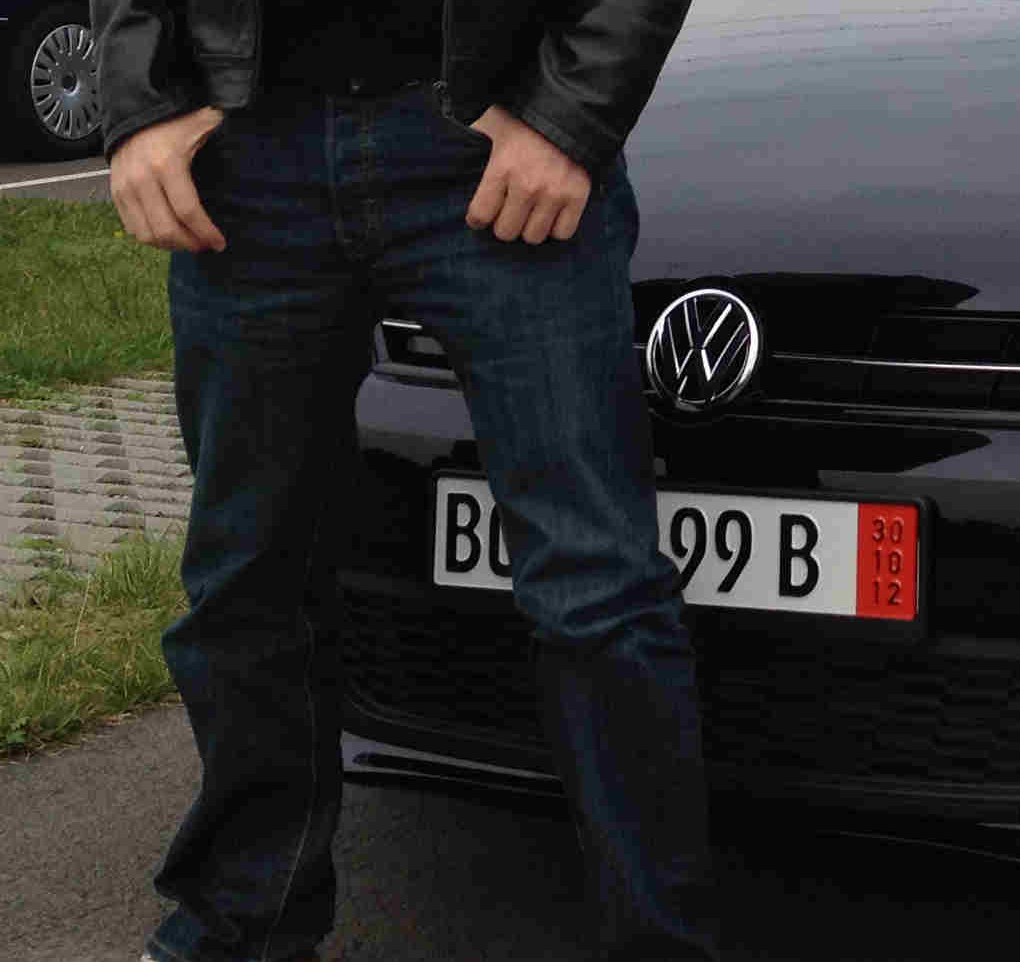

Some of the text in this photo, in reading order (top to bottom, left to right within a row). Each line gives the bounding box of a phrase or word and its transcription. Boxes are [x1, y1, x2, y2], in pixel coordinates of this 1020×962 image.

[872, 518, 903, 543] 30
[778, 513, 820, 598] B
[873, 549, 903, 575] 10
[873, 579, 902, 606] 12
